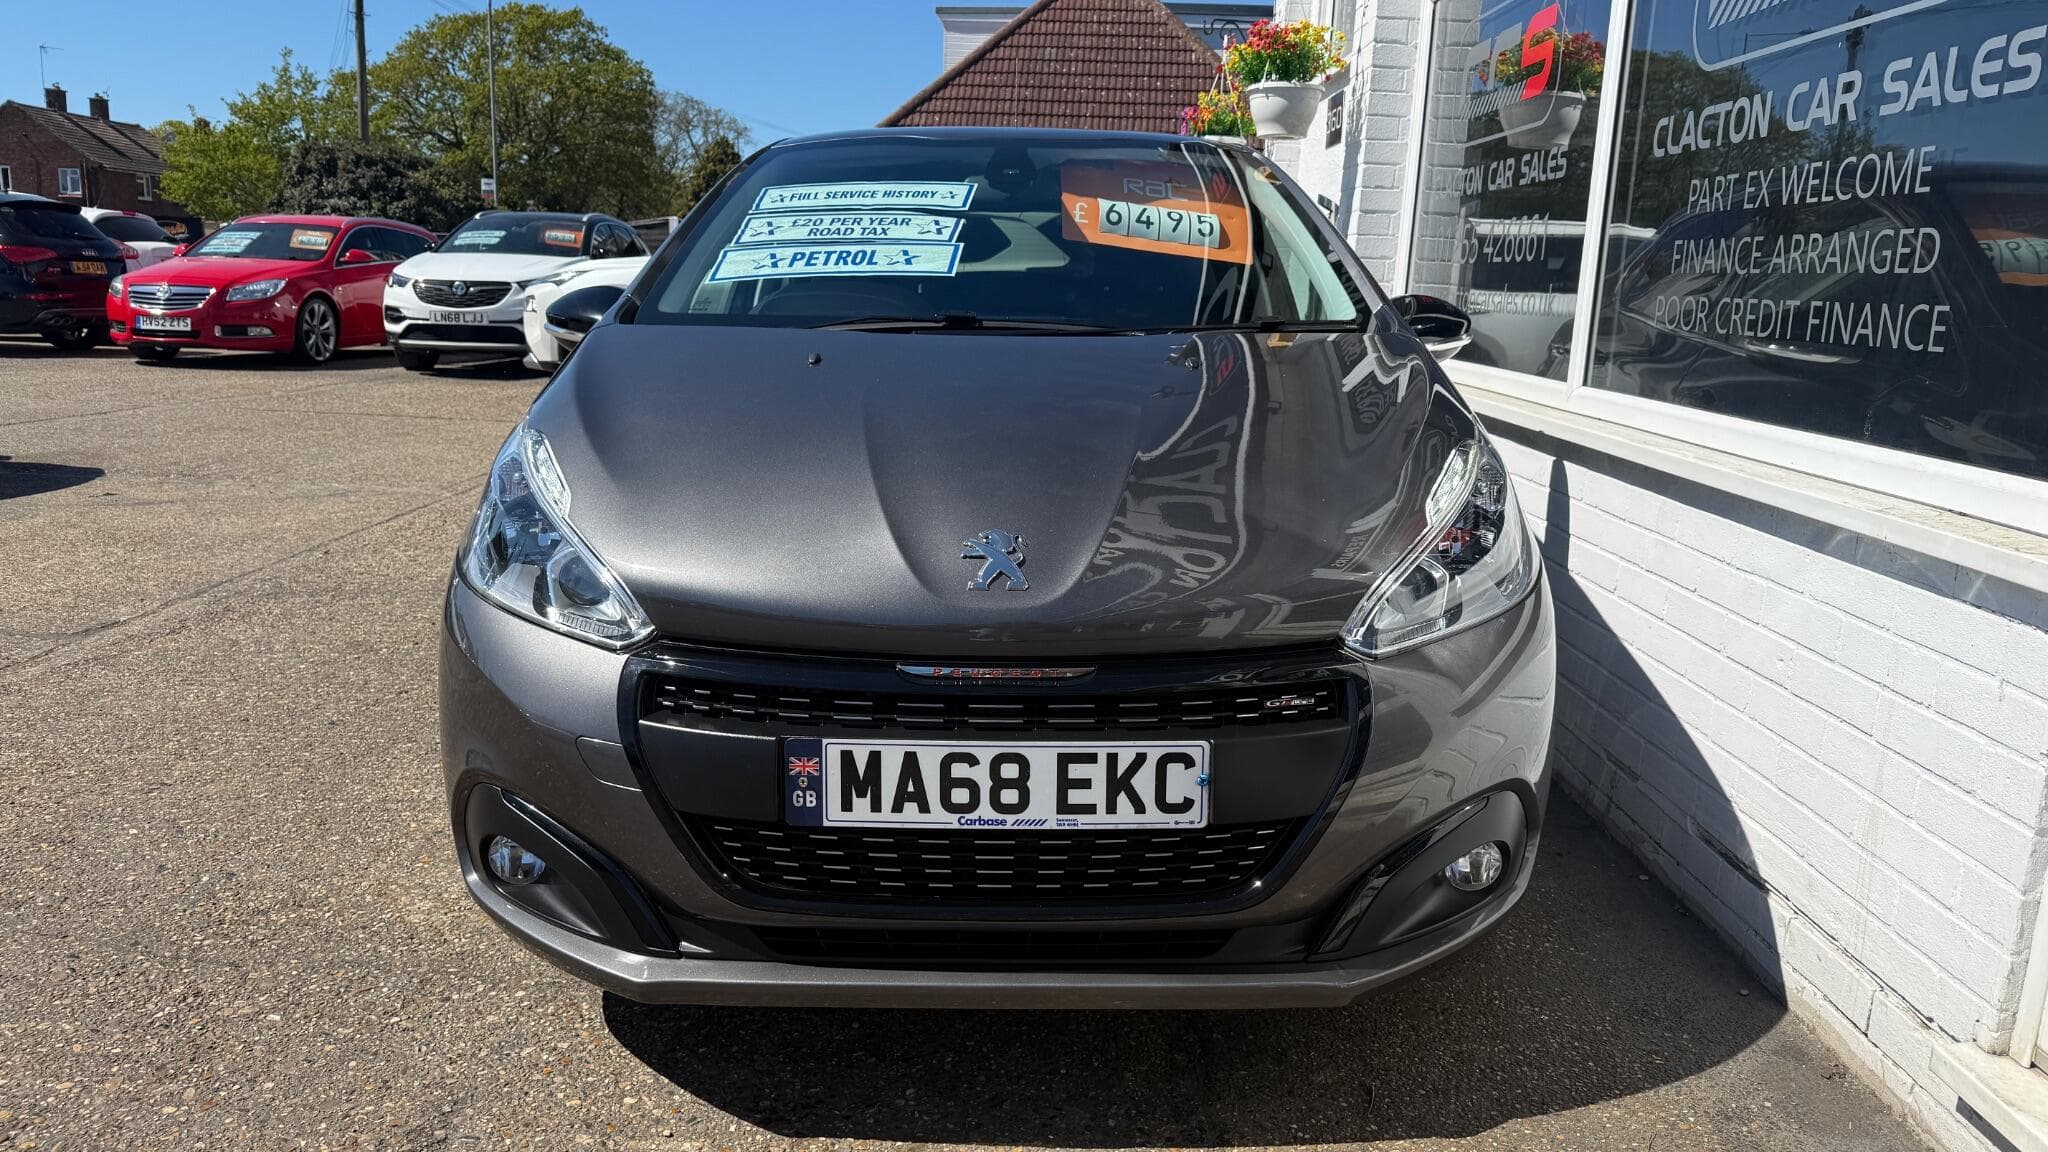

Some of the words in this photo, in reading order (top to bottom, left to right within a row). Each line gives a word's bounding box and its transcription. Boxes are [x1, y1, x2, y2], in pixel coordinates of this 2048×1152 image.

[1652, 91, 1774, 158] CLACTON
[1786, 70, 1862, 132] CAR
[1879, 25, 2048, 117] SALES
[1487, 157, 1515, 192] CAR
[1519, 146, 1568, 186] SALES
[1687, 173, 1739, 214] PART
[1743, 168, 1775, 210] EX
[1781, 145, 1936, 206] WELCOME
[789, 192, 820, 201] FULL
[824, 190, 880, 200] SERVICE
[882, 190, 939, 200] HISTORY
[791, 218, 824, 227] £20
[829, 217, 862, 226] PER
[863, 217, 912, 226] YEAR
[1105, 203, 1214, 238] 6495
[807, 227, 854, 237] ROAD
[856, 227, 891, 236] TAX
[787, 250, 879, 268] PETROL
[1670, 235, 1765, 275] FINANCE
[1768, 227, 1941, 275] ARRANGED
[169, 316, 189, 328] ZTS
[434, 312, 460, 323] LN68
[1654, 295, 1709, 333] POOR
[1715, 297, 1801, 340] CREDIT
[1805, 301, 1951, 353] FINANCE
[840, 750, 1031, 815] MA68
[1056, 751, 1196, 815] EKC
[791, 789, 818, 808] GB
[957, 816, 1008, 828] Carbase
